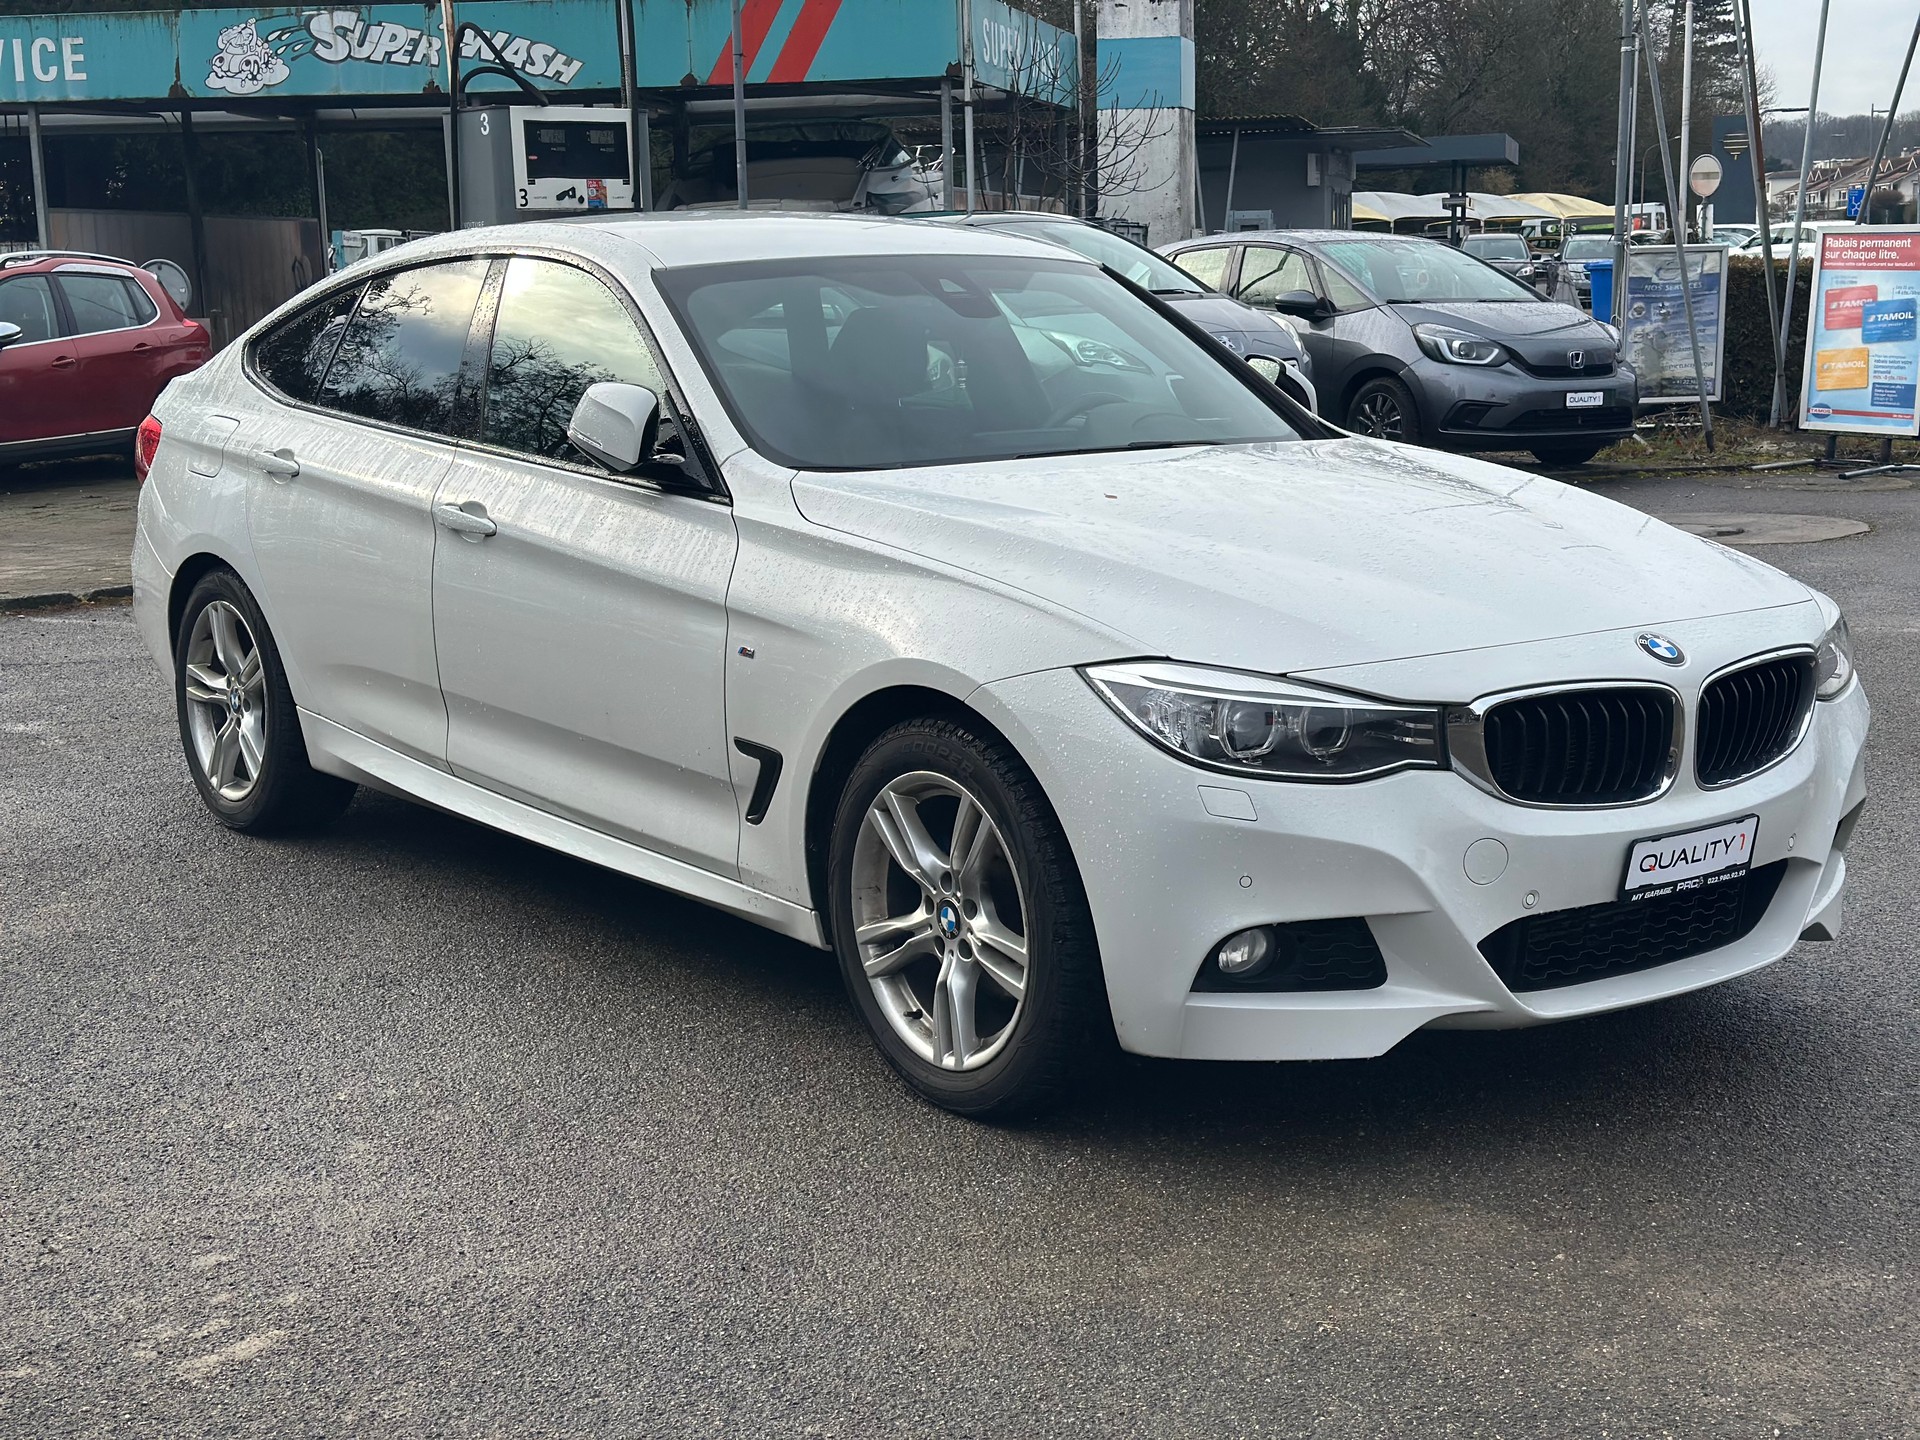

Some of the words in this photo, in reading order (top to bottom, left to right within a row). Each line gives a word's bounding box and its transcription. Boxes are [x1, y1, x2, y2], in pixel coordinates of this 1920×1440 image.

[304, 9, 443, 68] SUPER
[457, 28, 586, 85] WASH
[480, 112, 490, 136] 3
[518, 188, 529, 208] 3
[1826, 238, 1858, 248] Rabais
[1860, 238, 1912, 249] permanent
[1825, 250, 1840, 259] sur
[1842, 249, 1877, 261] chaque
[1878, 249, 1900, 259] litre.
[1877, 311, 1914, 322] TAMOIL
[1640, 835, 1737, 873] QUALITY
[1631, 893, 1644, 902] MY
